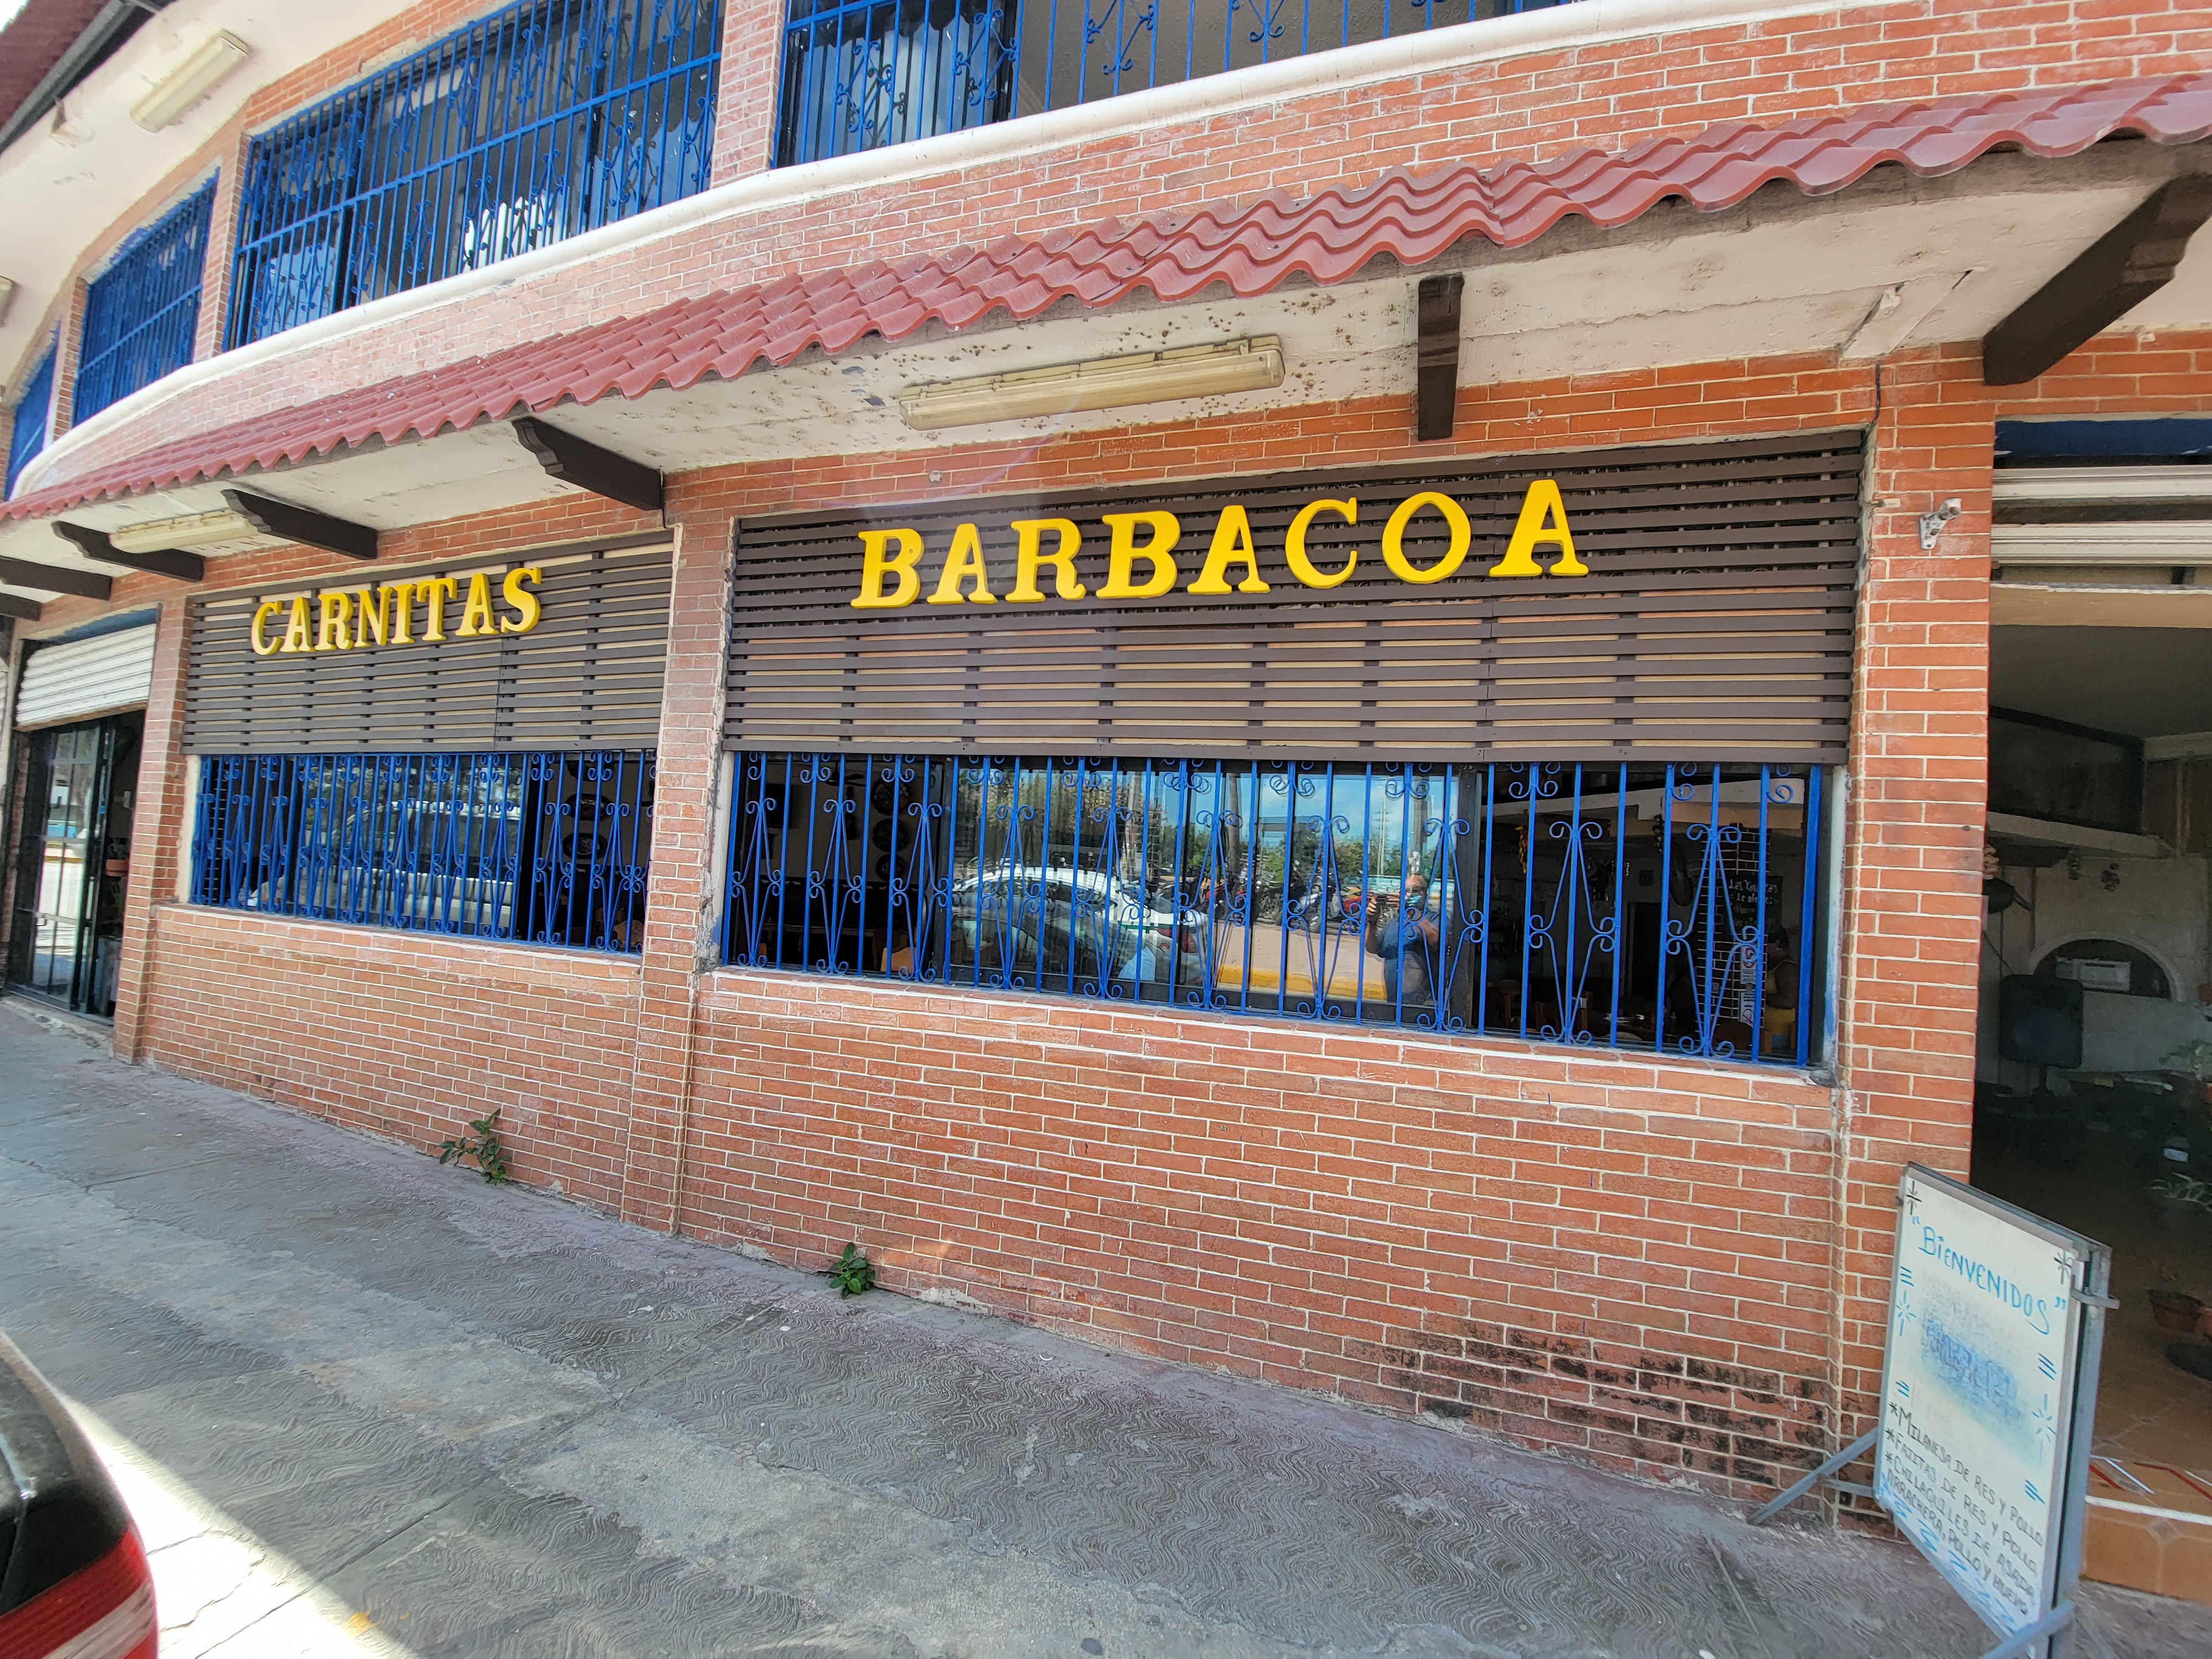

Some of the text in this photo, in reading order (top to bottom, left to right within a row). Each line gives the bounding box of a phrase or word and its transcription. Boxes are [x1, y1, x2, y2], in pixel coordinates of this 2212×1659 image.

[850, 479, 1589, 609] BARBACOA
[251, 566, 542, 656] CARNITAS
[1893, 1455, 1969, 1536] CHILAQUILES
[1972, 1531, 1991, 1557] DE
[1895, 1432, 1936, 1483] FAJITAS
[1941, 1477, 1957, 1500] DE
[1964, 1494, 1986, 1526] RES
[1992, 1521, 1999, 1537] Y
[1953, 1460, 1969, 1482] DE
[1974, 1475, 1995, 1505] RES
[1999, 1498, 2006, 1516] Y
[2010, 1506, 2043, 1546] POLLO
[1948, 1528, 1981, 1571] POLLO
[1983, 1563, 1992, 1581] Y
